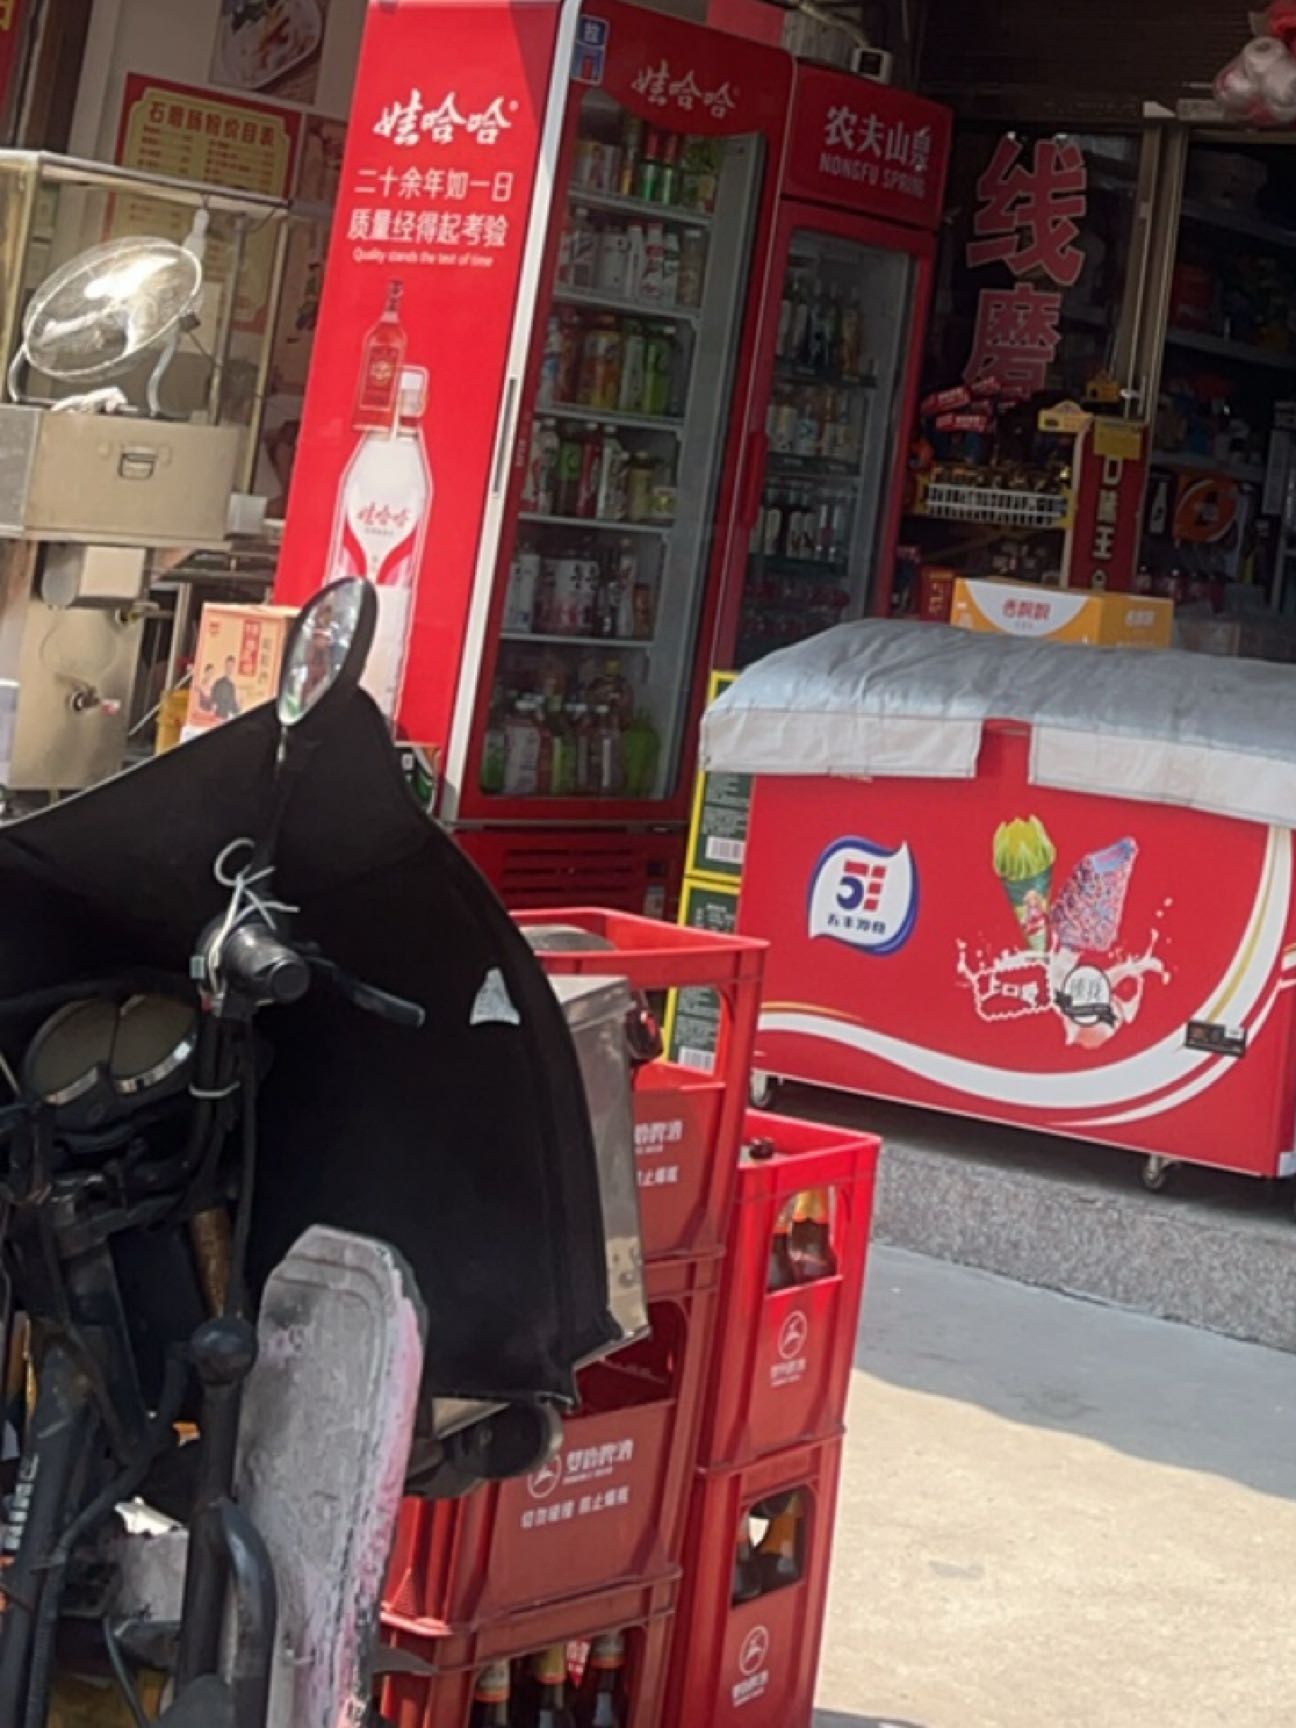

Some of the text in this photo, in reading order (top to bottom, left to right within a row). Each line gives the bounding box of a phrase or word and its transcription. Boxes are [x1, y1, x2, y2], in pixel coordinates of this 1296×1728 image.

[631, 58, 736, 120] 娃哈哈
[372, 87, 512, 146] 娃哈哈
[823, 105, 933, 174] 农夫山泉
[353, 166, 514, 203] 二十余年如一日
[819, 152, 879, 186] NONGFU
[347, 207, 508, 248] 质量经得起考验
[353, 246, 385, 265] Quality
[420, 251, 435, 265] the
